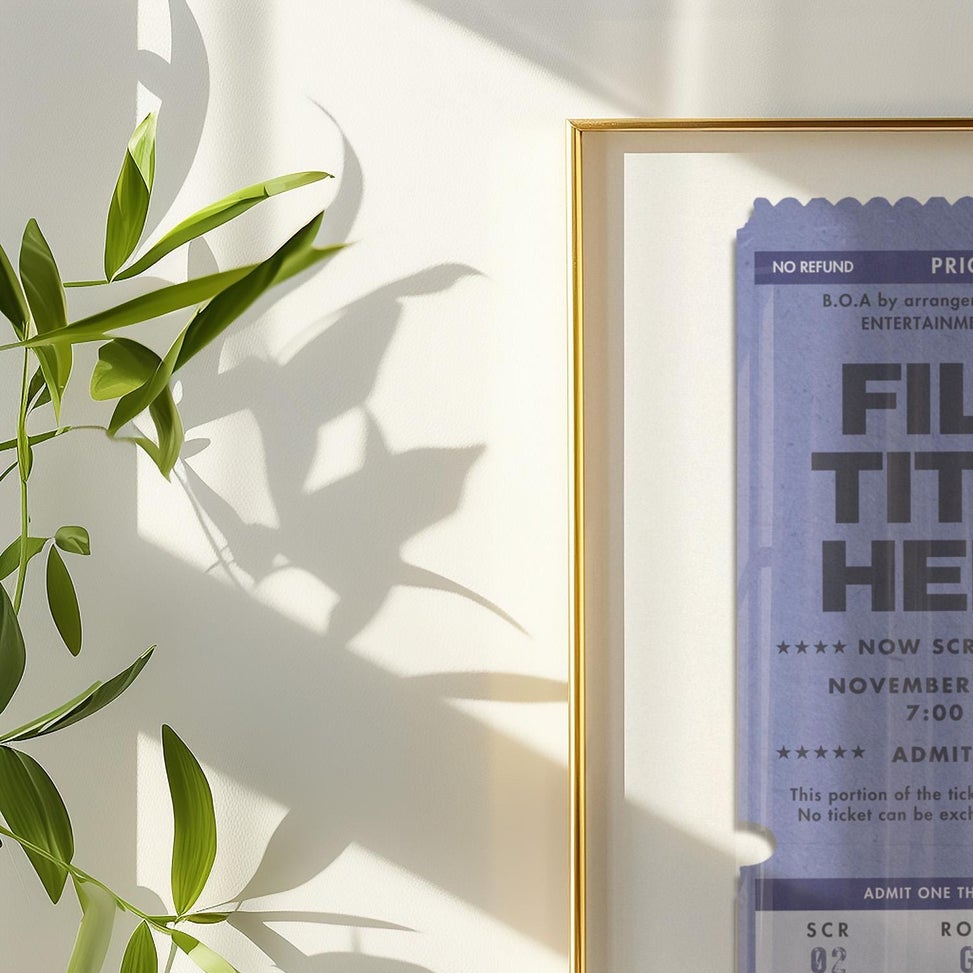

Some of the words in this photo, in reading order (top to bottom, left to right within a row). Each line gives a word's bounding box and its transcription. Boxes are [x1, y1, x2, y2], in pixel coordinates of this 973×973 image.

[773, 260, 797, 274] NO
[800, 260, 854, 273] REFUND
[822, 293, 871, 307] B.O.A
[877, 292, 897, 310] by
[858, 639, 921, 655] NOW
[906, 705, 964, 722] 7:00
[892, 746, 972, 762] ADMIT
[790, 787, 822, 802] This
[828, 787, 888, 804] portion
[894, 786, 912, 801] of
[916, 786, 942, 801] the
[798, 808, 822, 822] No
[827, 807, 873, 821] ticket
[878, 809, 907, 821] can
[913, 806, 933, 821] be
[864, 887, 912, 900] ADMIT
[918, 887, 951, 900] ONE
[806, 922, 849, 938] SCR
